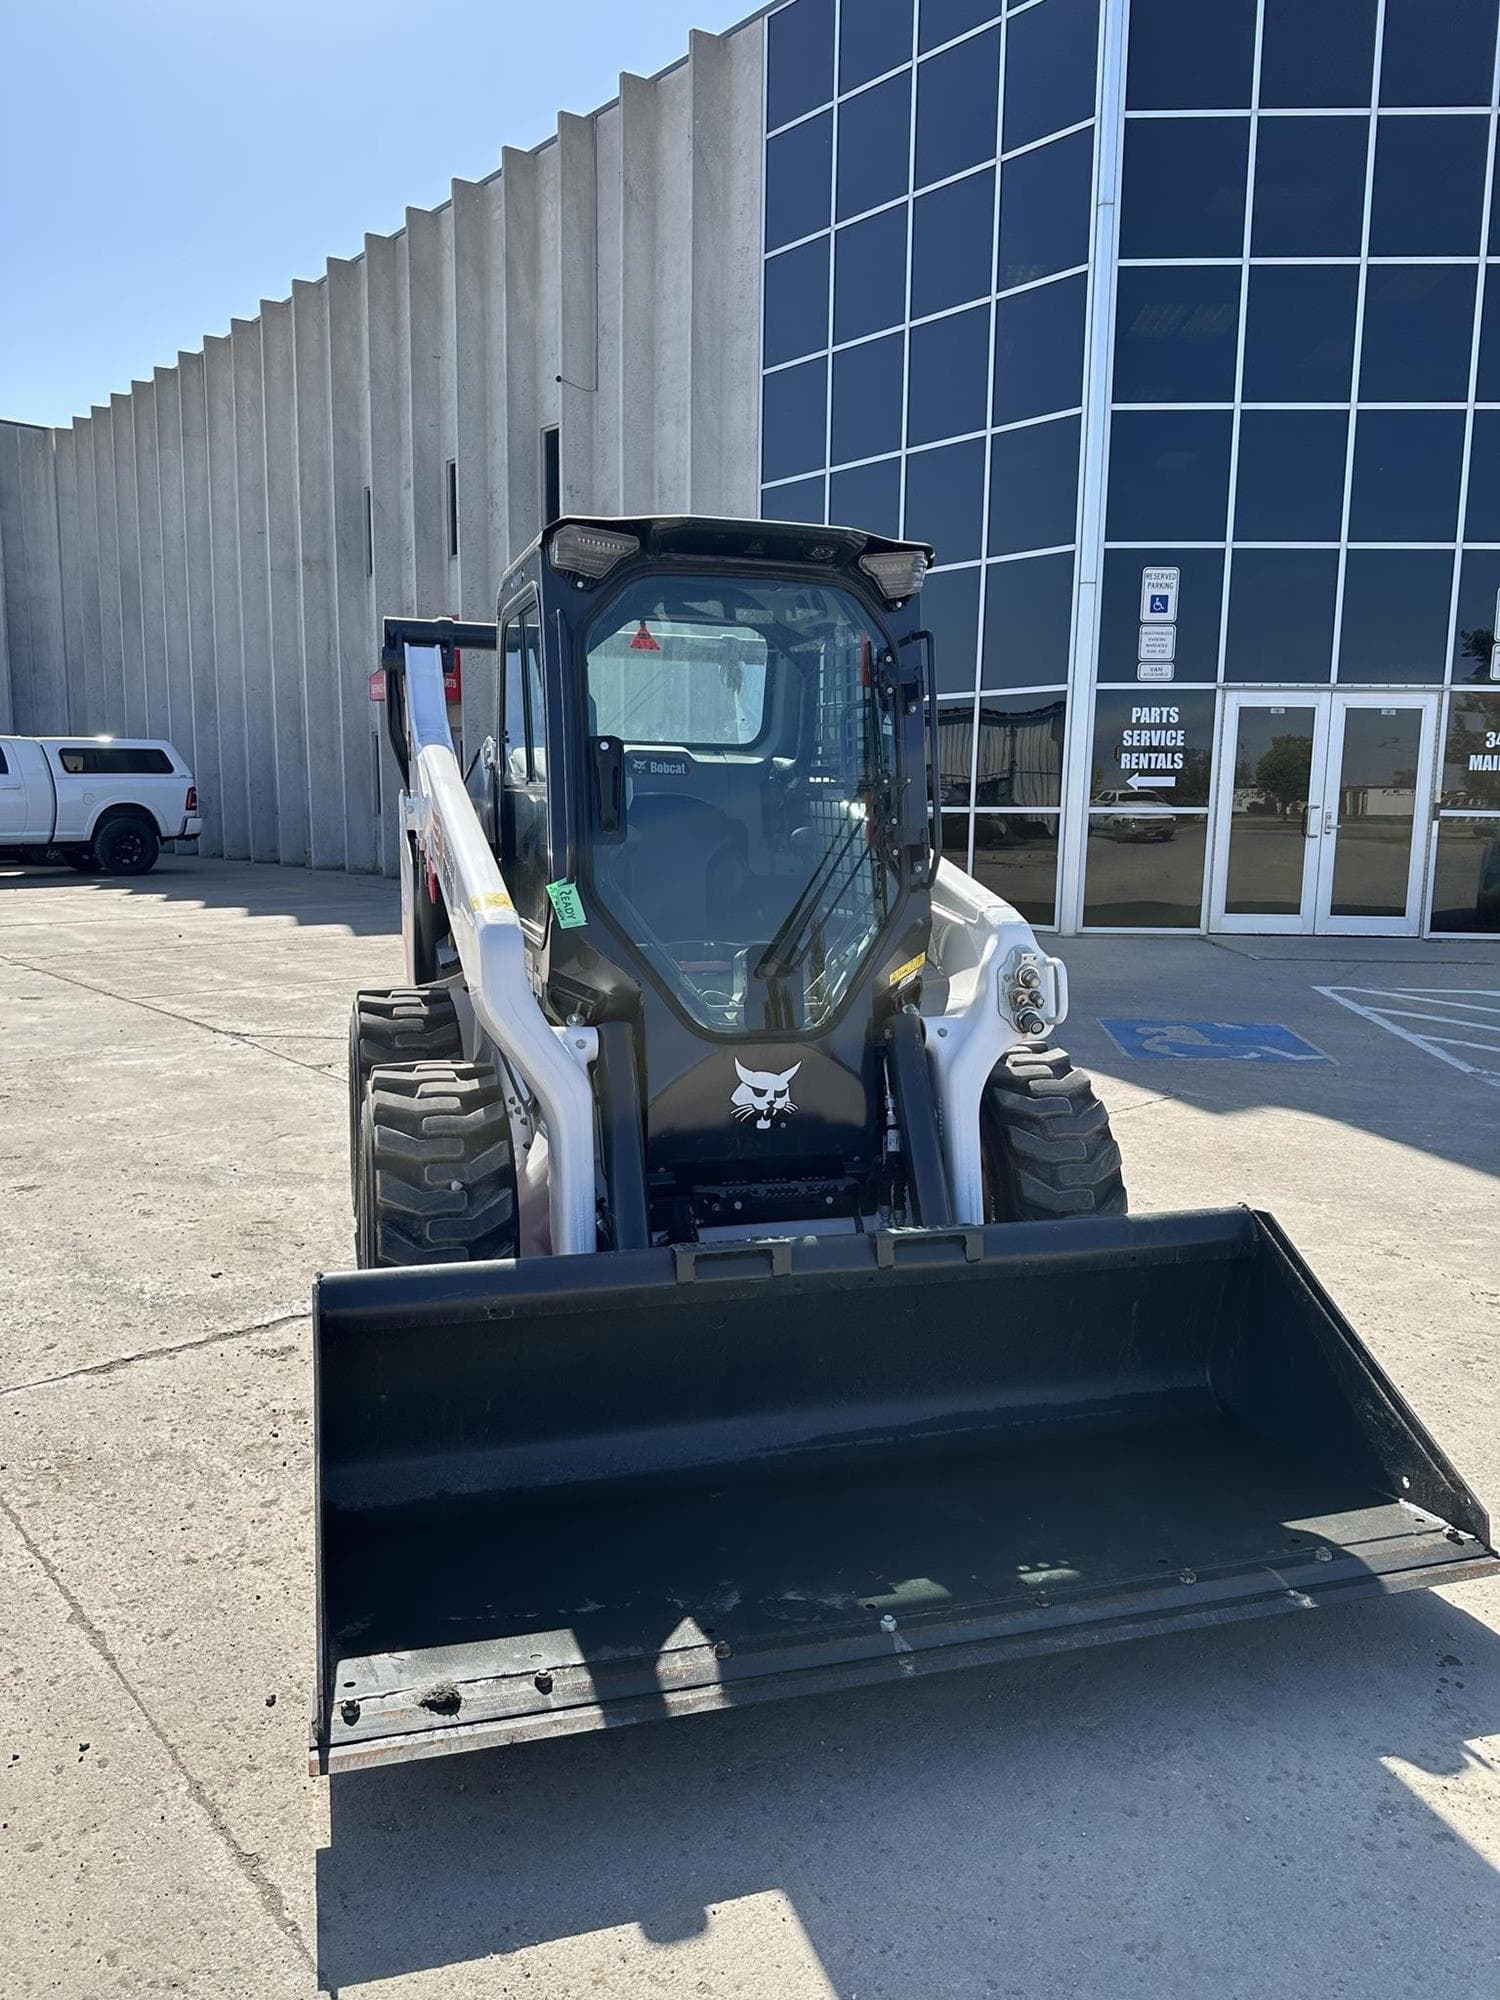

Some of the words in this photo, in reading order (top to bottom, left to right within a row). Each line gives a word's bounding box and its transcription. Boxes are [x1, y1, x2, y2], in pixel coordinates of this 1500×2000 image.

[1145, 572, 1176, 580] RESERVED
[1147, 581, 1174, 589] PARKING
[1131, 707, 1179, 723] PARTS
[1122, 730, 1185, 746] SERVICE
[650, 761, 686, 774] Bobcat
[1120, 753, 1184, 769] RENTALS
[1469, 754, 1500, 771] MAI
